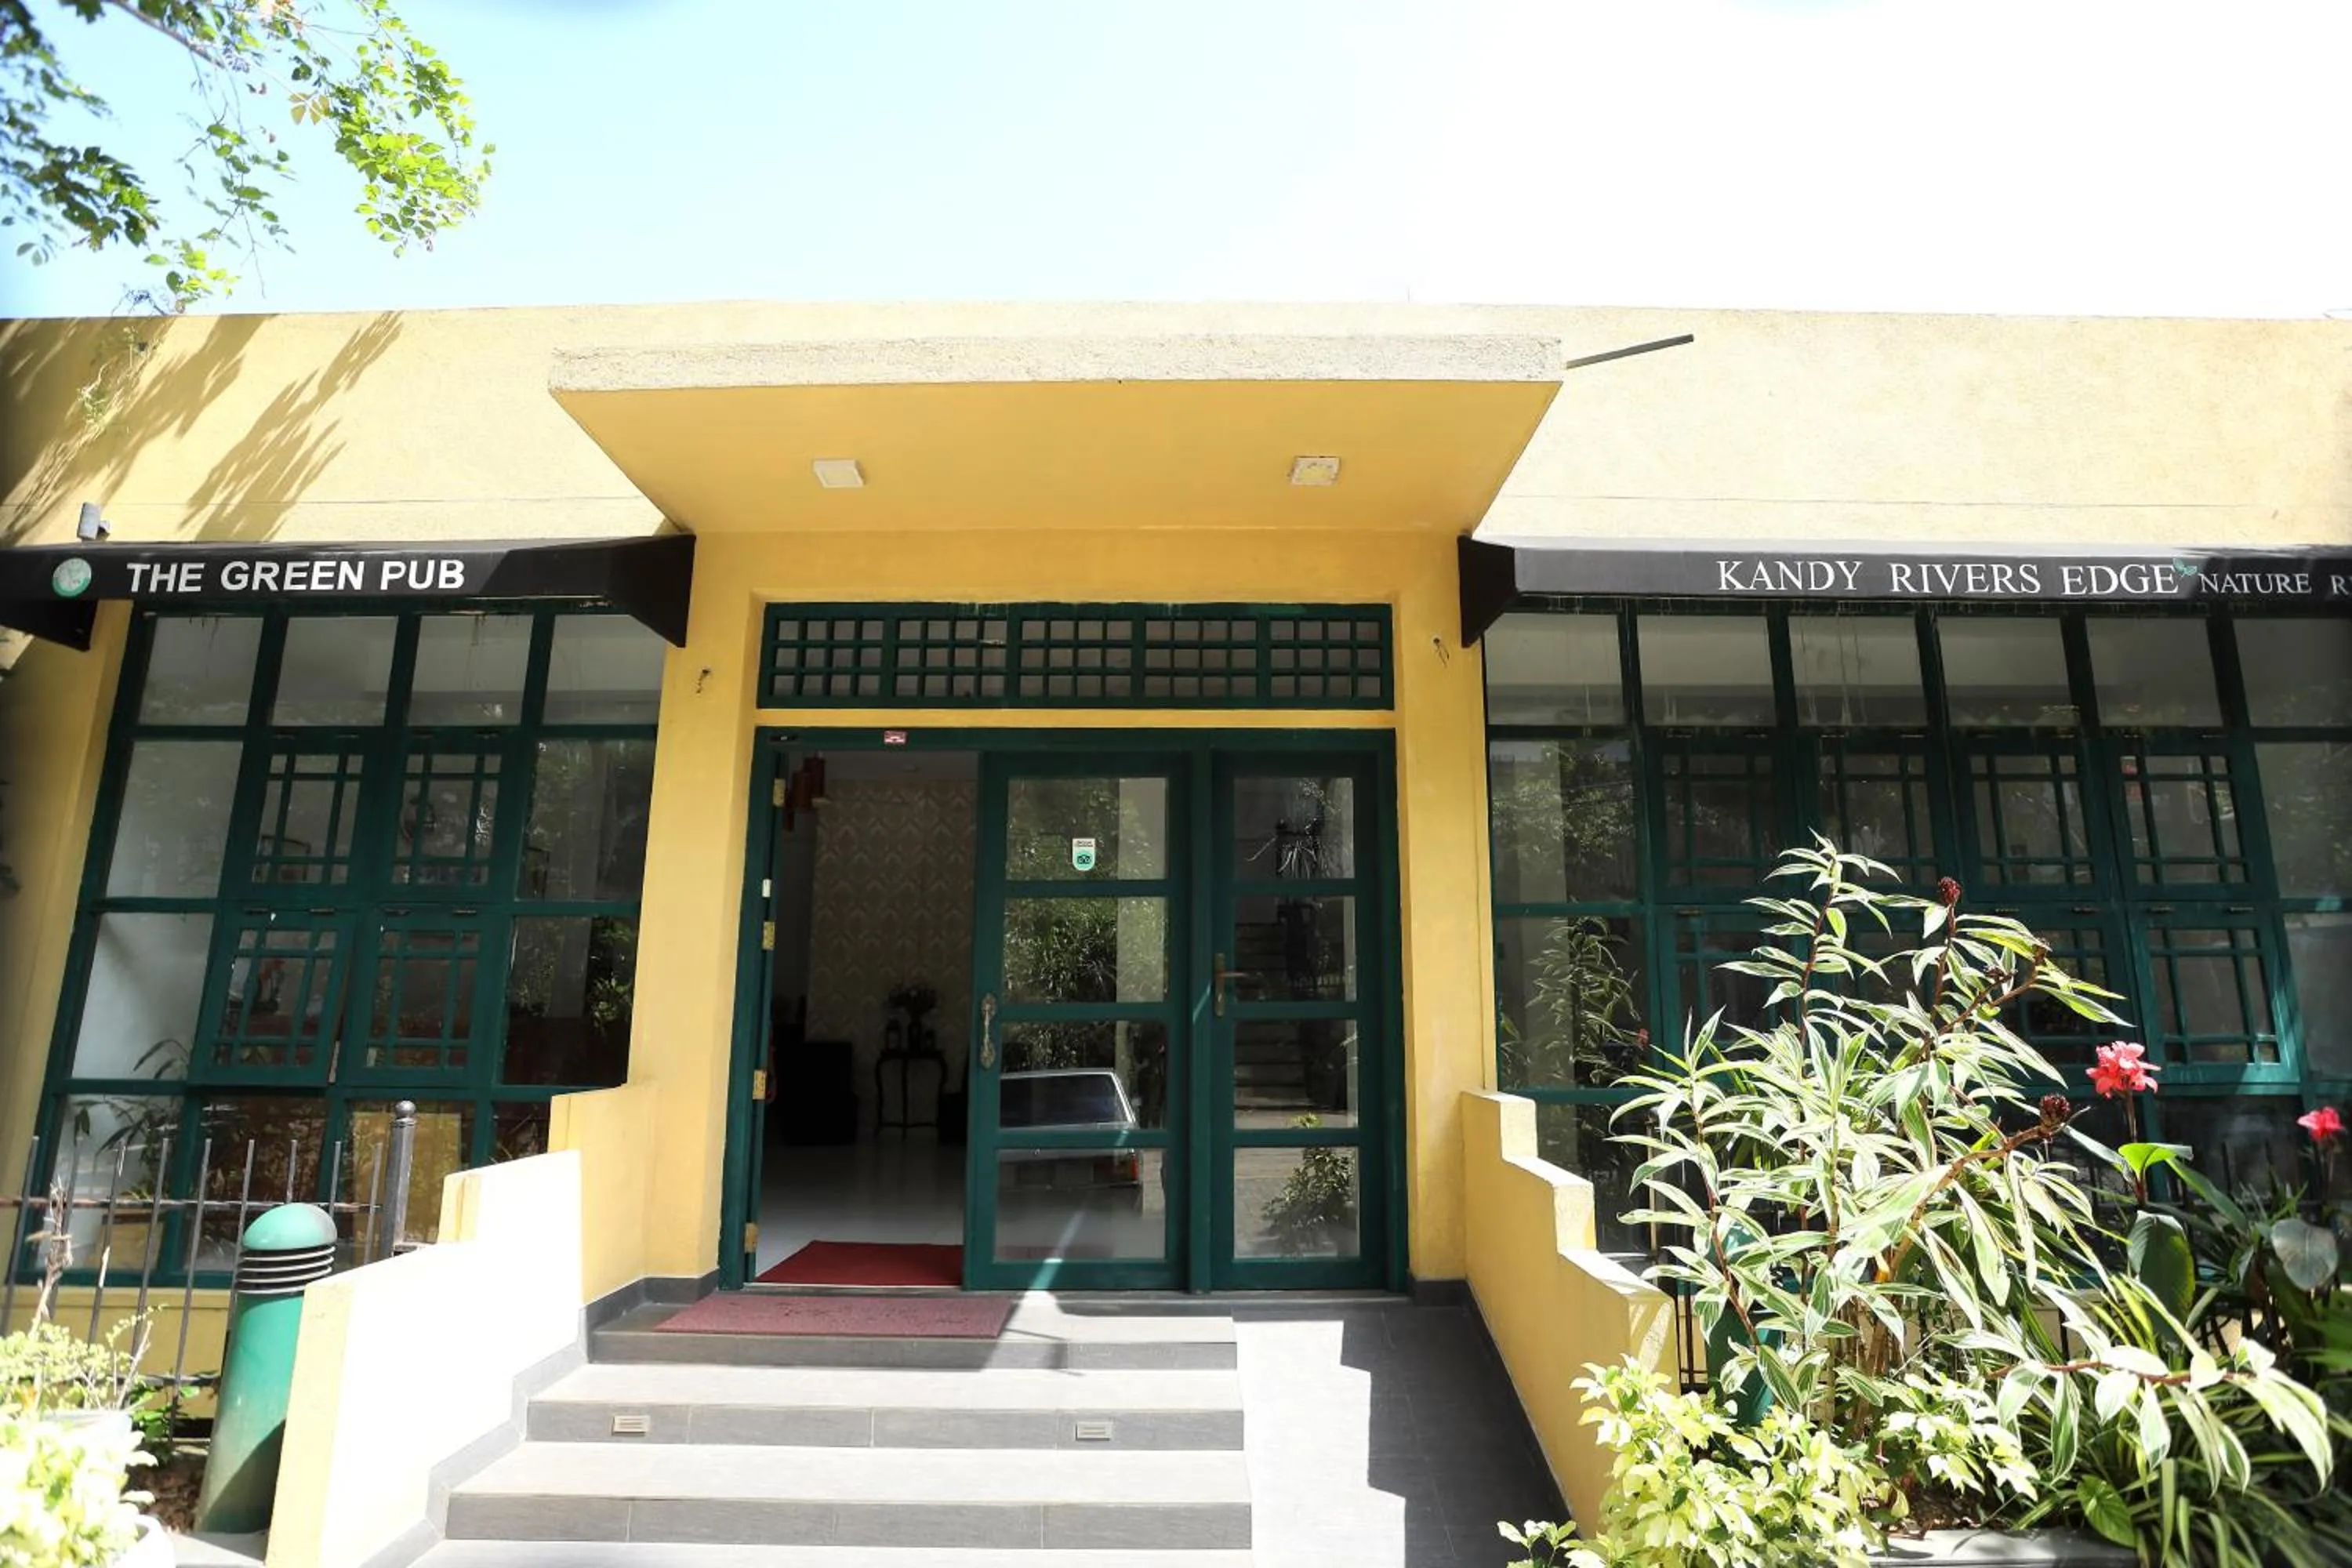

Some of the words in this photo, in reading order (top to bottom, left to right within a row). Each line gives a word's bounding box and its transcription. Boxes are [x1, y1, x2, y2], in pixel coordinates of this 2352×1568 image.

[126, 562, 205, 593] THE
[220, 561, 365, 591] GREEN
[380, 559, 465, 590] PUB
[1715, 559, 1864, 590] KANDY
[1887, 562, 2042, 594] RIVERS
[2059, 564, 2179, 596] EDGE
[2198, 572, 2313, 594] NATURE
[2329, 574, 2352, 595] R
